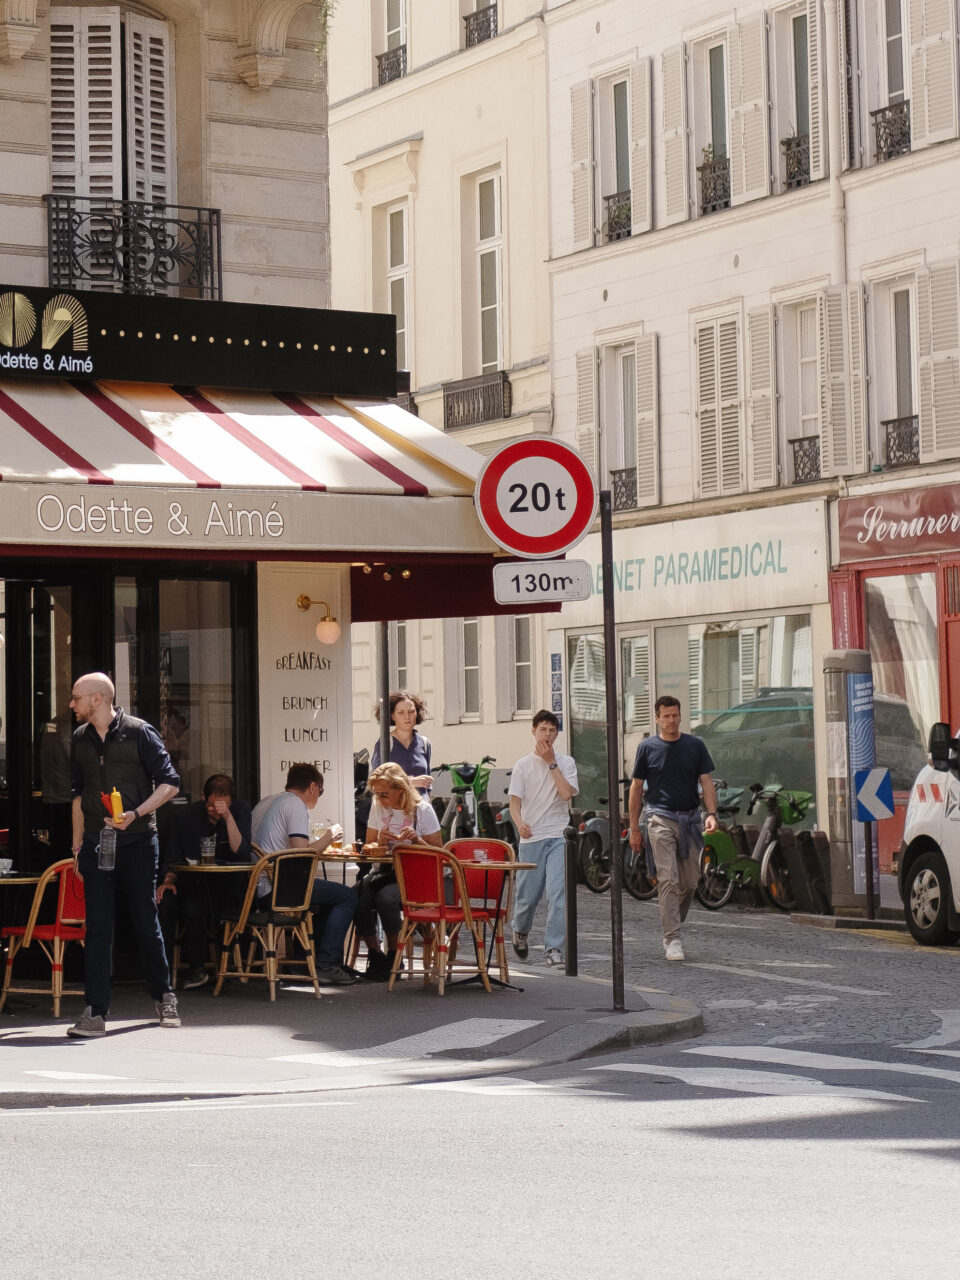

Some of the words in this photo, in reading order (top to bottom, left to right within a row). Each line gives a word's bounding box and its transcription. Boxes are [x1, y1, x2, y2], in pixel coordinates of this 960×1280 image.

[43, 353, 55, 371] &
[58, 355, 94, 373] Aimé
[37, 494, 154, 535] Odette
[167, 502, 191, 536] &
[204, 501, 285, 538] Aimé
[653, 539, 788, 587] PARAMEDICAL
[511, 573, 573, 593] 130m
[276, 651, 332, 671] BREAKFAST
[282, 696, 328, 710] BRUNCH
[284, 728, 328, 742] LUNCH
